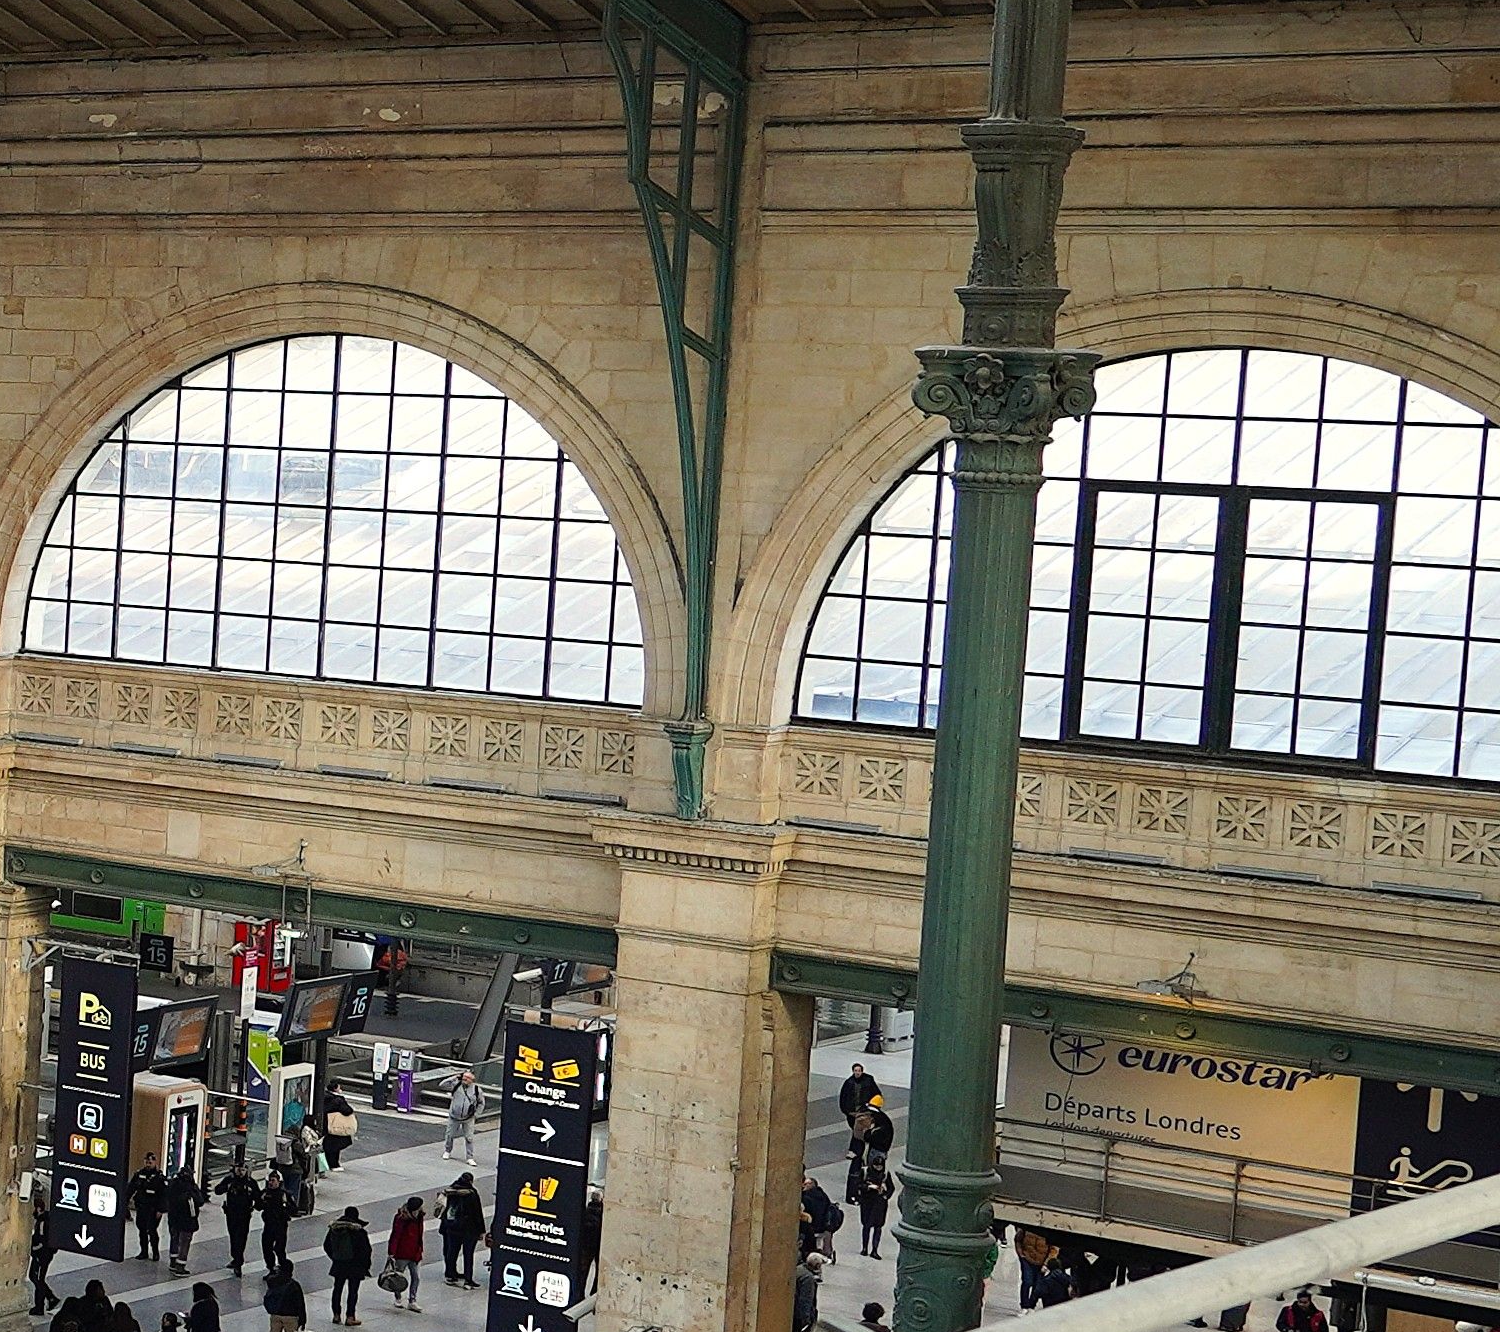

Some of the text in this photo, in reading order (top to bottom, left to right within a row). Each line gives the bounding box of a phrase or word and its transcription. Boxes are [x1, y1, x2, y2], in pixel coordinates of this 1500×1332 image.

[147, 944, 166, 963] 15
[553, 961, 567, 980] 17
[352, 995, 367, 1016] 16
[134, 1033, 148, 1054] 15
[79, 1052, 106, 1070] BUS
[1117, 1046, 1311, 1091] eurostar
[525, 1081, 566, 1099] Change
[1045, 1092, 1242, 1140] Départs Londres
[510, 1216, 565, 1236] Billetteries
